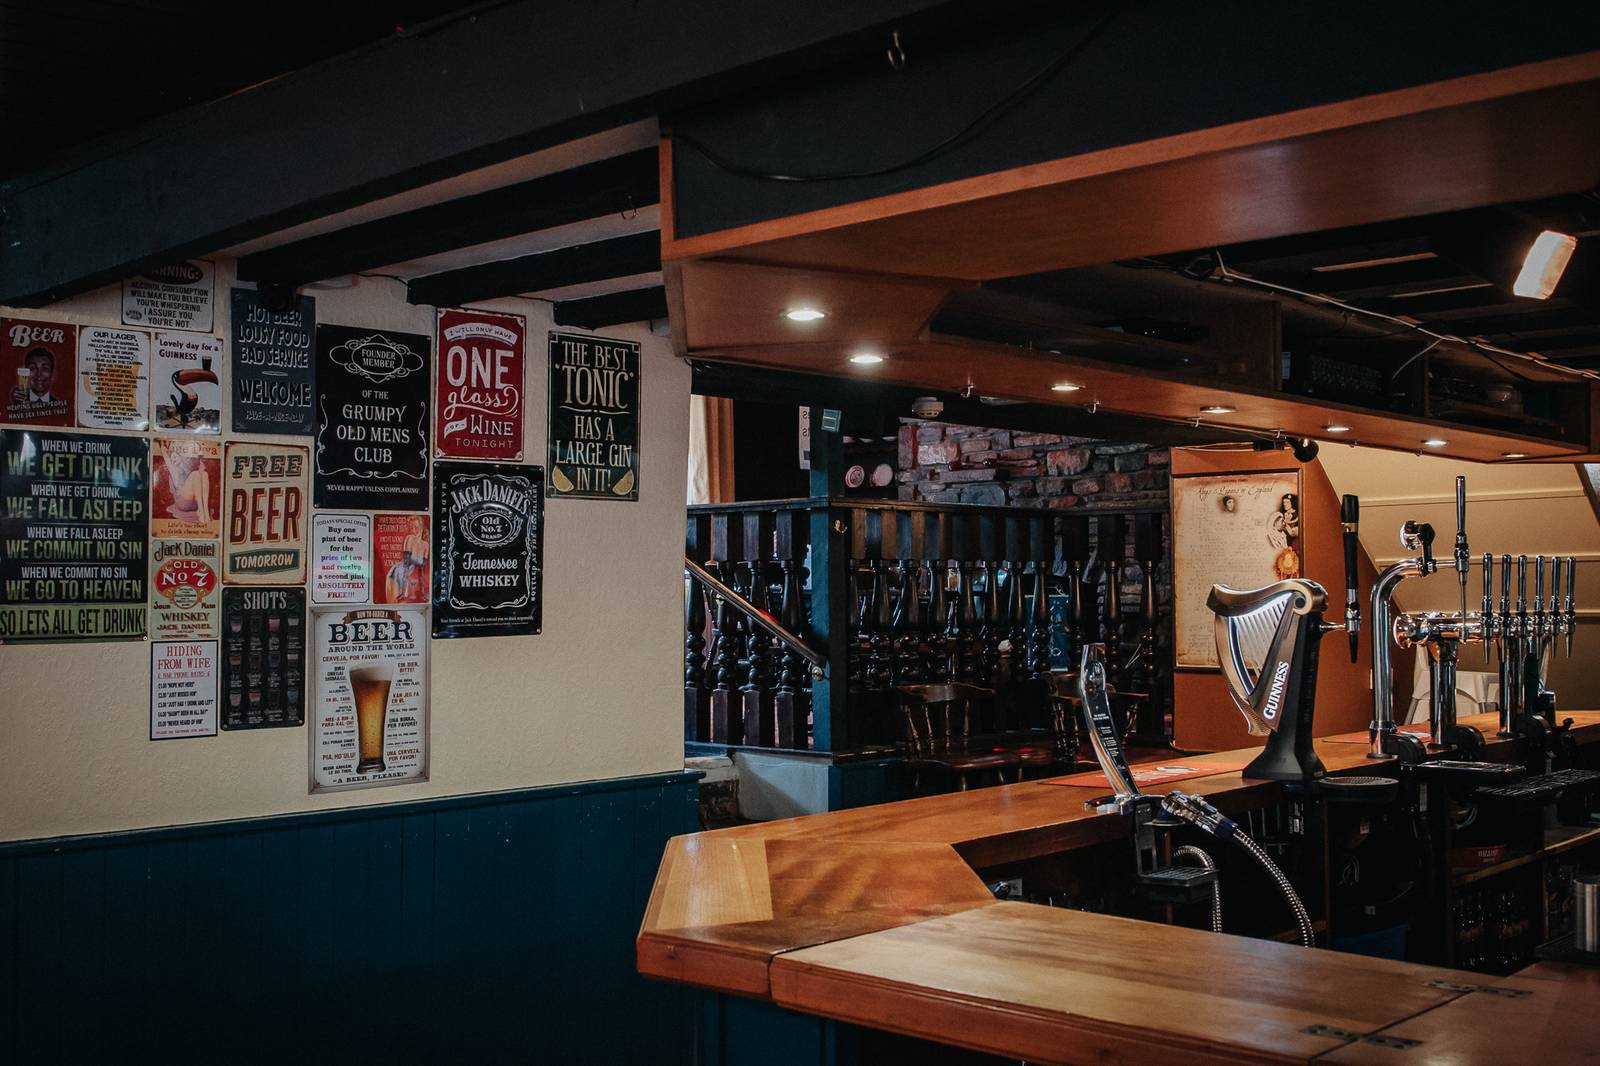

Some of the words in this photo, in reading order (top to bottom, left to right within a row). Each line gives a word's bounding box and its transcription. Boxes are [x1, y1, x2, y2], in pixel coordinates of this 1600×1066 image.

[131, 290, 146, 298] WILL
[148, 291, 166, 300] MAKE
[182, 294, 208, 304] BELIEVE
[162, 284, 209, 296] CONSUMPTION
[136, 298, 159, 308] YOU'RE
[149, 308, 177, 319] ASSURE
[179, 311, 194, 320] YOU.
[248, 304, 270, 324] HOT
[148, 318, 174, 326] YOU'RE
[176, 320, 192, 328] NOT.
[9, 324, 65, 347] BEER
[111, 334, 137, 342] LAGER,
[238, 324, 275, 345] LOUSY
[277, 329, 310, 349] FOOD
[494, 330, 512, 340] HAVE
[160, 338, 184, 349] Lovely
[186, 342, 199, 351] day
[202, 343, 212, 351] for
[159, 350, 198, 361] GUINNESS
[240, 347, 265, 365] BAD
[268, 348, 309, 368] SERVICE
[361, 349, 396, 361] FOUNDER
[562, 341, 591, 367] THE
[594, 345, 629, 371] BEST
[362, 358, 395, 369] MEMBER
[447, 346, 515, 389] ONE
[240, 379, 311, 407] WELCOME
[562, 365, 629, 409] TONIC
[362, 390, 372, 398] OF
[374, 391, 389, 400] THE
[444, 386, 514, 420] glass
[342, 404, 407, 423] GRUMPY
[470, 414, 514, 436] WINE
[574, 415, 602, 441] HAS
[606, 418, 615, 441] A
[336, 425, 366, 441] OLD
[371, 428, 411, 444] MENS
[42, 440, 68, 453] WHEN
[70, 441, 84, 453] WE
[85, 442, 111, 455] DRINK
[455, 437, 513, 448] TONIGHT
[354, 447, 393, 464] CLUB
[555, 440, 605, 466] LARGE
[609, 444, 632, 468] GIN
[7, 451, 36, 477] WE
[42, 453, 78, 478] GET
[82, 456, 142, 481] DRUNK
[232, 455, 303, 479] FREE
[576, 468, 591, 491] IN
[595, 468, 612, 492] IT!
[31, 484, 57, 497] WHEN
[58, 485, 73, 497] WE
[74, 486, 91, 498] GET
[451, 485, 482, 514] JACK
[482, 479, 532, 515] DANIEL'S
[6, 496, 34, 519] WE
[38, 498, 78, 520] FALL
[82, 500, 143, 521] ASLEEP
[230, 487, 302, 545] BEER
[441, 520, 447, 532] IN
[482, 517, 500, 526] Old
[27, 526, 51, 539] WHEN
[55, 527, 69, 539] WE
[70, 528, 90, 539] FALL
[92, 528, 124, 540] ASLEEP
[328, 527, 341, 535] Buy
[6, 539, 30, 559] WE
[34, 540, 93, 560] COMMIT
[96, 541, 115, 559] NO
[120, 541, 142, 560] SIN
[184, 542, 215, 556] Daniel
[174, 561, 198, 569] OLD
[235, 553, 295, 569] TOMORROW
[463, 552, 518, 571] Tennessee
[22, 566, 48, 578] WHEN
[50, 567, 64, 578] WE
[65, 567, 99, 578] COMMIT
[101, 567, 112, 578] NO
[113, 567, 128, 578] SIN
[192, 572, 209, 587] 7
[459, 575, 520, 588] WHISKEY
[6, 579, 30, 600] WE
[35, 580, 56, 600] GO
[60, 580, 78, 600] TO
[83, 580, 142, 600] HEAVEN
[244, 592, 287, 610] SHOTS
[0, 609, 16, 635] SO
[20, 609, 49, 635] LETS
[53, 609, 75, 635] ALL
[78, 609, 100, 634] GET
[103, 608, 146, 634] DRUNK!
[161, 613, 210, 622] WHISKEY
[356, 611, 366, 619] HOW
[328, 622, 414, 644] BEER
[167, 646, 202, 657] HIDING
[328, 645, 364, 653] AROUND
[158, 659, 182, 670] FROM
[187, 658, 211, 669] WIFE
[1263, 661, 1290, 720] GUINNESS
